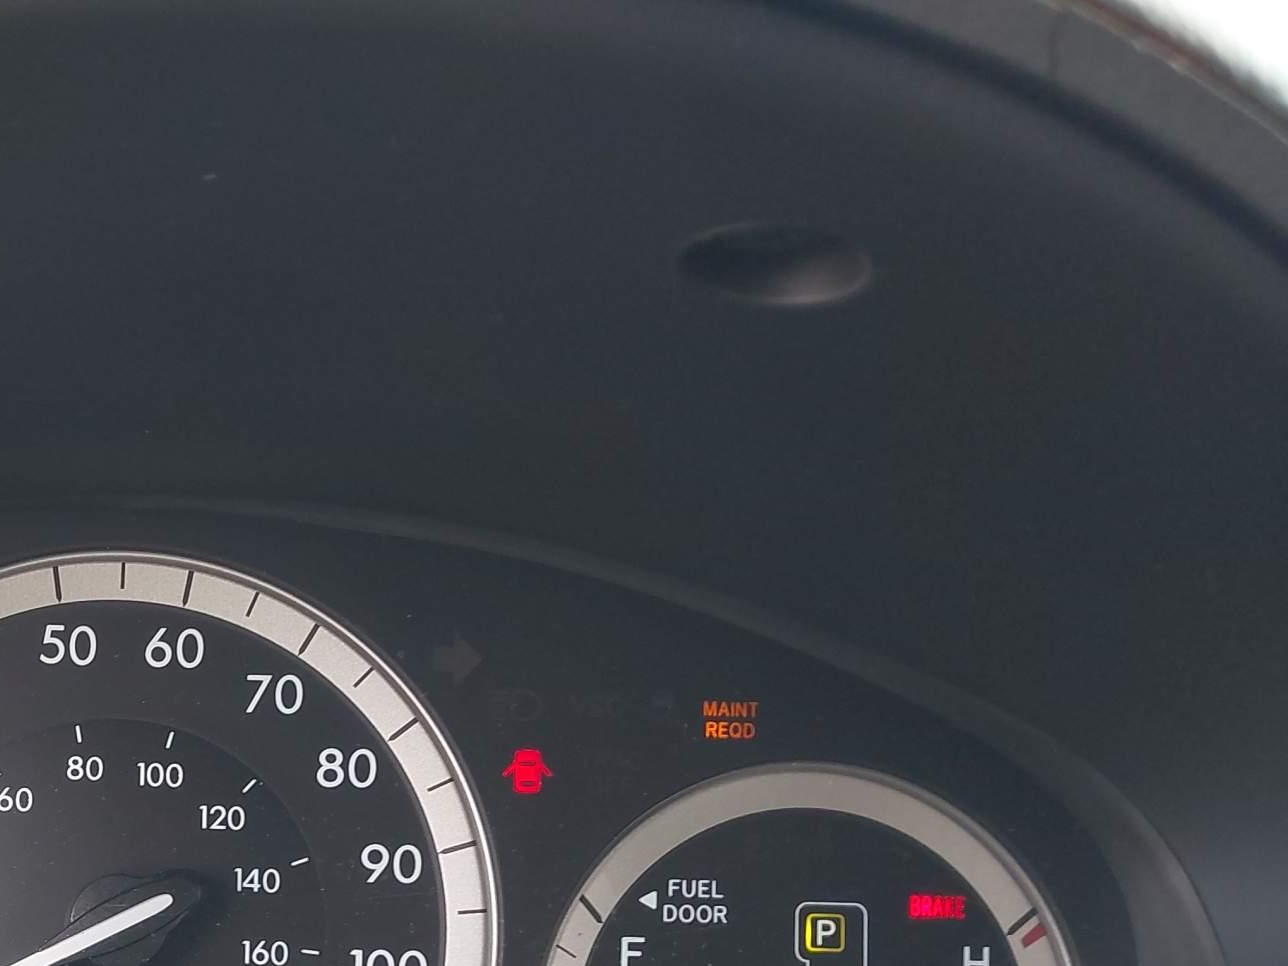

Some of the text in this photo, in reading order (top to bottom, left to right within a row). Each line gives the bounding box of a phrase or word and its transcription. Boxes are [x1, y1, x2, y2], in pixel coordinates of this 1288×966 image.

[40, 625, 96, 665] 50
[145, 628, 203, 668] 60
[246, 675, 303, 714] 70
[702, 701, 758, 718] MAINT
[705, 721, 756, 739] REQD
[67, 756, 103, 780] 80
[138, 763, 183, 787] 100
[317, 748, 376, 788] 80
[200, 806, 244, 830] 120
[361, 844, 421, 883] 90
[235, 868, 280, 893] 140
[669, 879, 723, 898] FUEL
[663, 905, 727, 923] DOOR
[908, 894, 966, 919] BRAKE
[815, 919, 837, 945] P
[243, 941, 288, 965] 160
